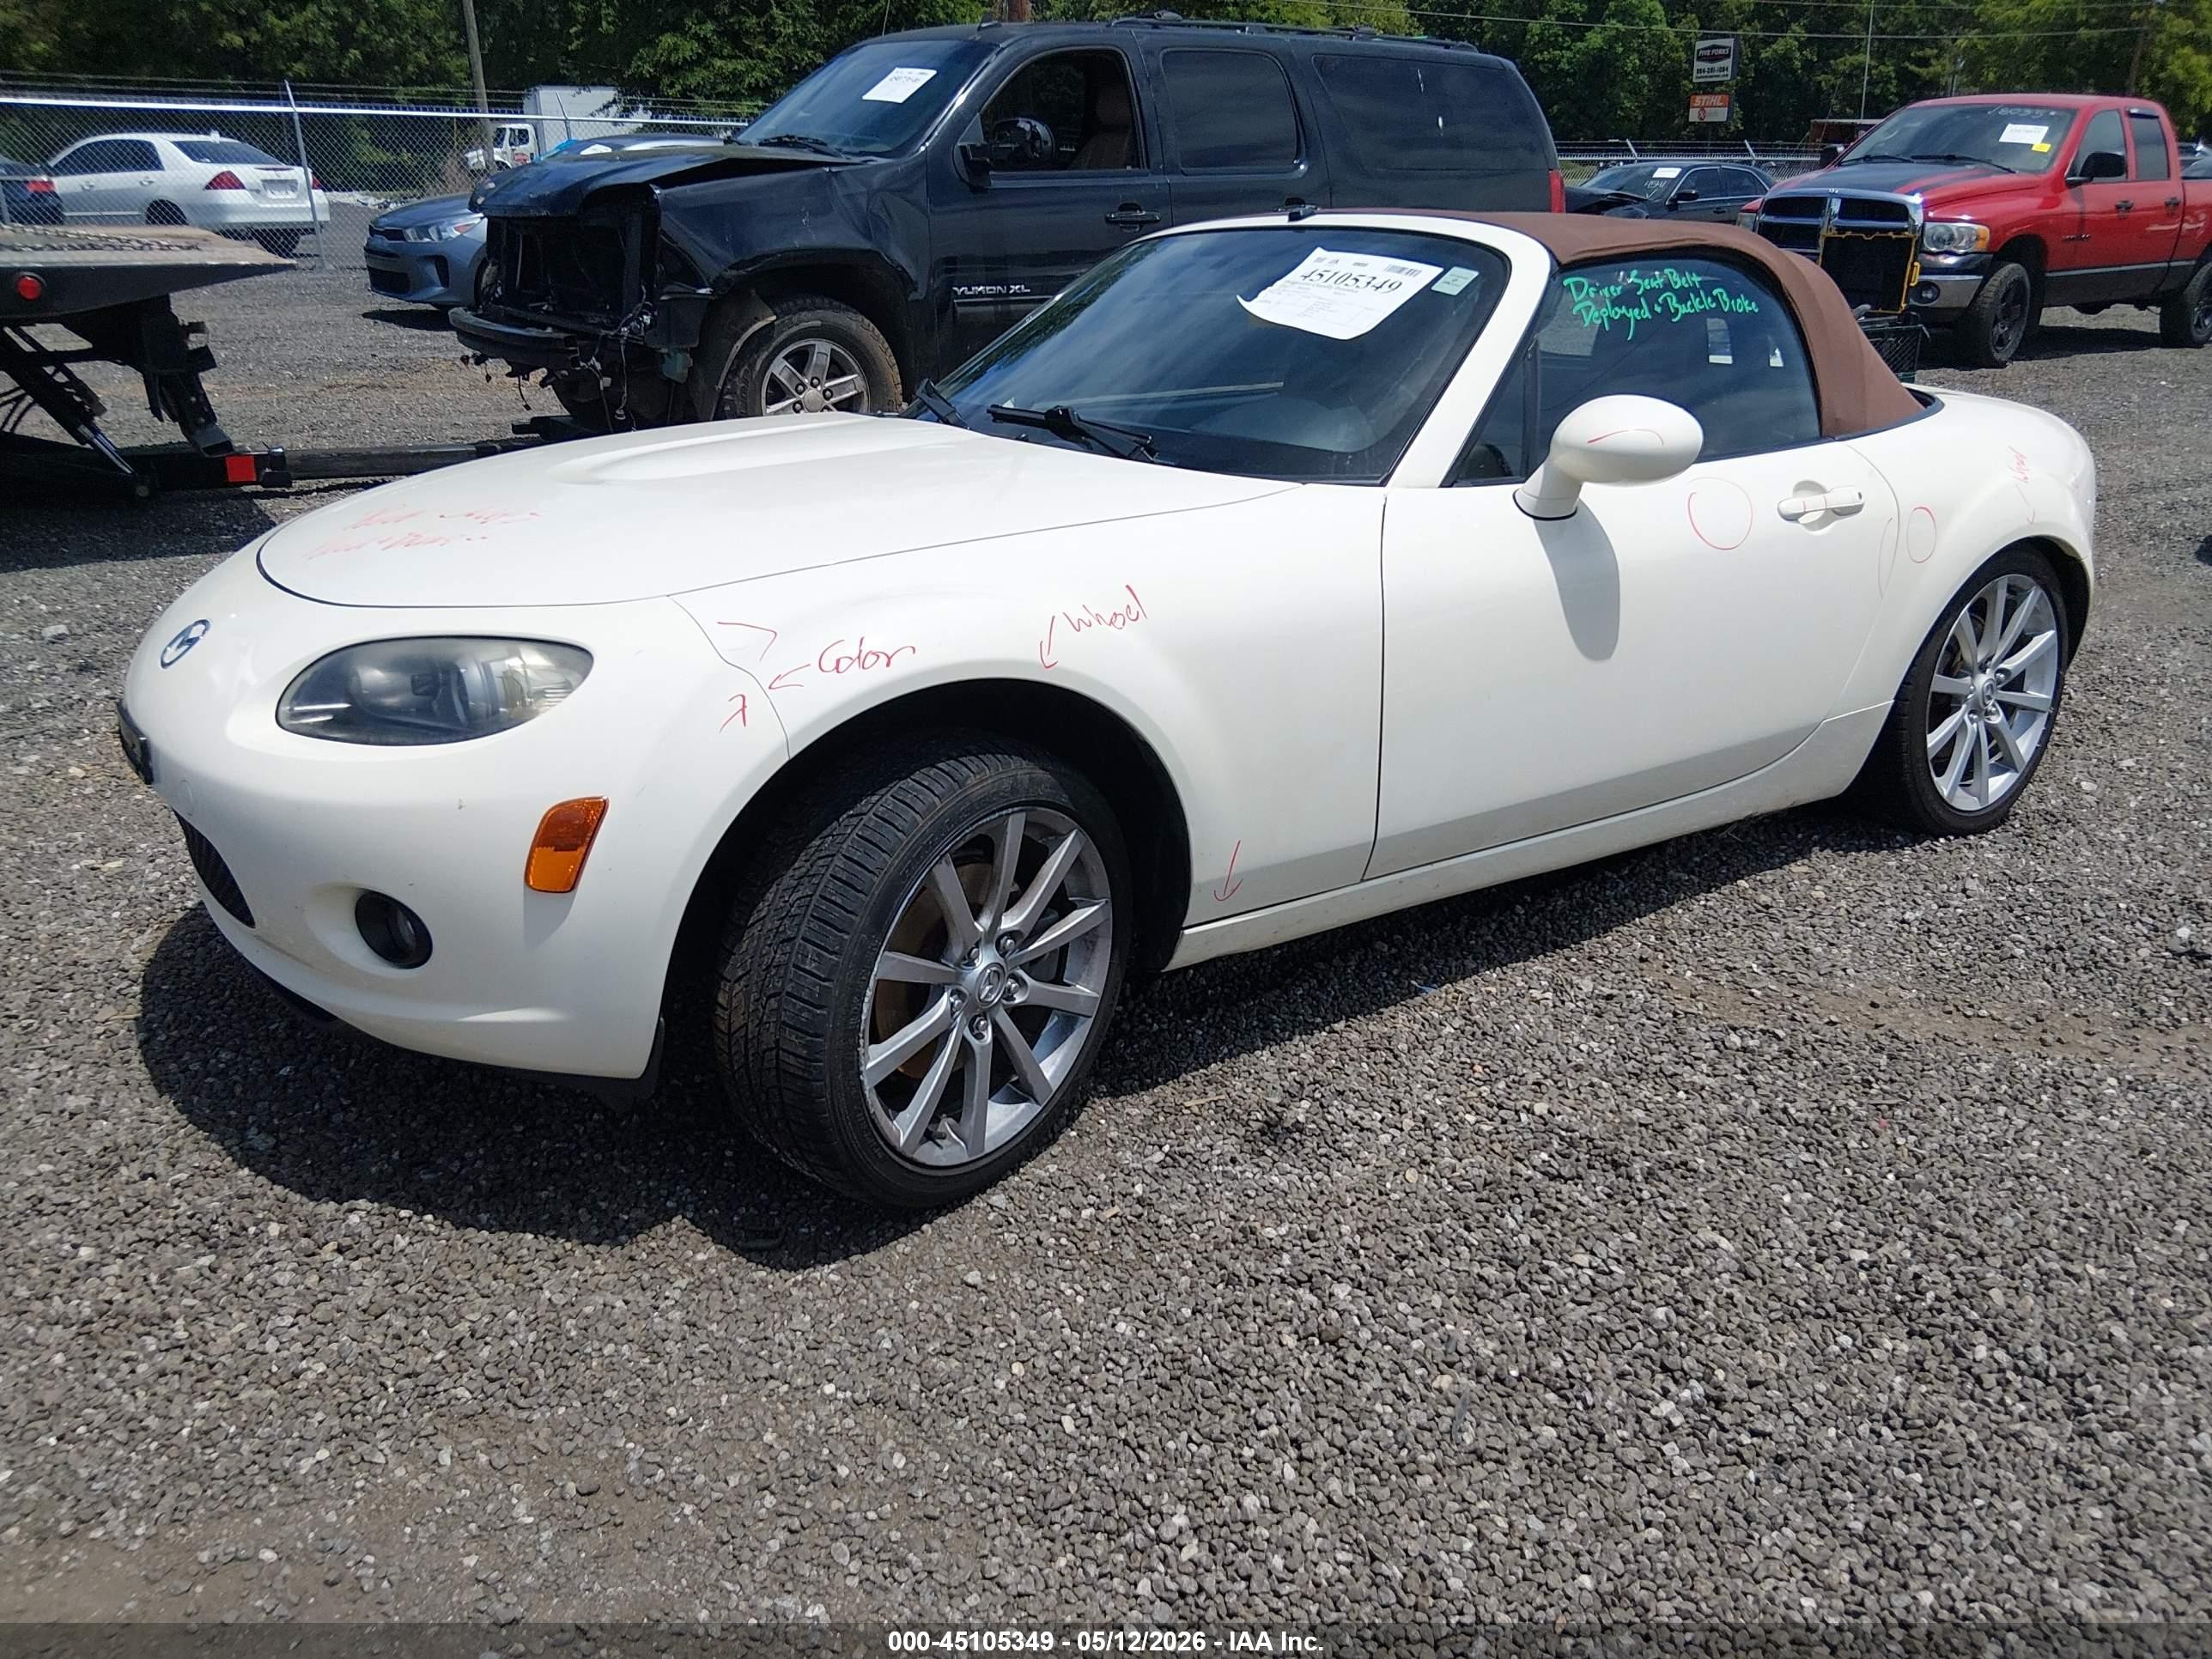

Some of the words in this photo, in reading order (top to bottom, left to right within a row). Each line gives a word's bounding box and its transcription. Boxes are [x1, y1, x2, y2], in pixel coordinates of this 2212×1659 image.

[1693, 95, 1724, 106] STIHL
[952, 286, 1006, 295] YUKON
[1009, 284, 1030, 294] XL
[1300, 267, 1404, 295] 45105349
[1563, 276, 1623, 302] Driver
[1629, 269, 1664, 295] Seat
[1664, 267, 1703, 289] Belt
[1572, 297, 1652, 342] Deployed
[1658, 291, 1716, 323] Buckle
[1712, 289, 1759, 314] Broke
